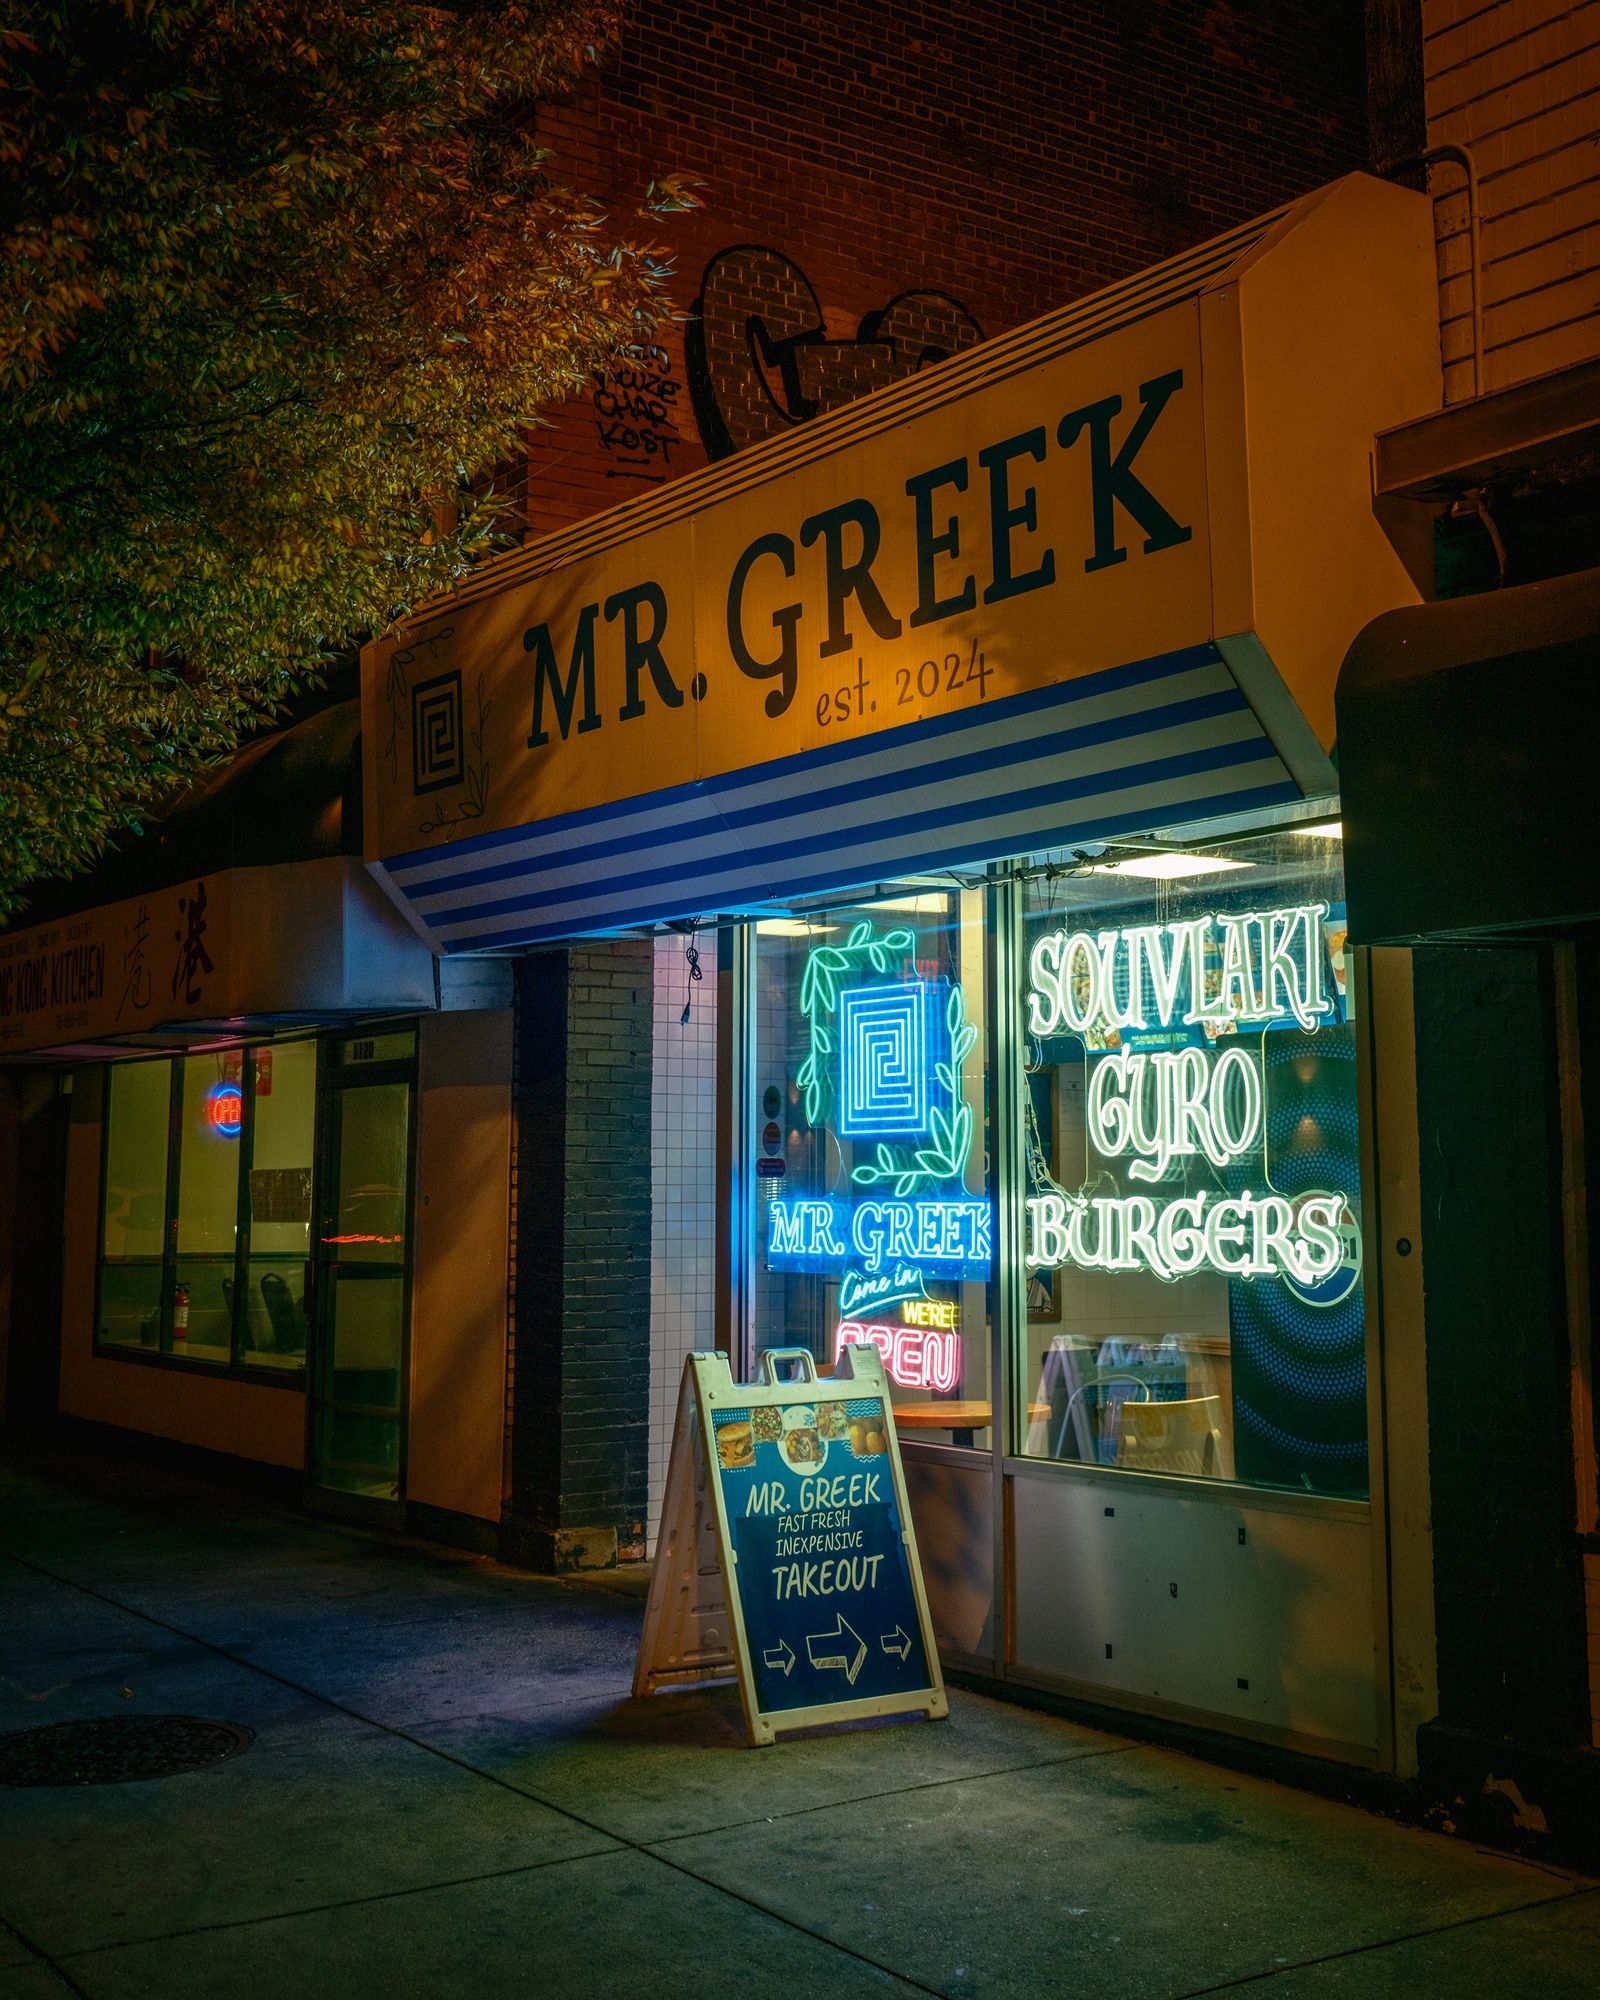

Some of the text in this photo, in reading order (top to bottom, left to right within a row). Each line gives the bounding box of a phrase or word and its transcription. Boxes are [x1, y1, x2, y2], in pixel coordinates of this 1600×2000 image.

[523, 369, 1191, 749] MR. GREEK
[816, 638, 994, 726] est. 2024
[16, 955, 47, 1016] KONG
[51, 942, 104, 1008] KITCHEN
[1030, 904, 1329, 1034] SOUVLAKI
[1088, 1043, 1260, 1182] GYRO
[770, 1201, 990, 1272] MR. GREEK
[1026, 1190, 1342, 1284] BURGERS
[841, 1263, 918, 1310] Come in
[746, 1472, 881, 1518] MR. GREEK
[778, 1509, 850, 1533] FAST FRESH
[772, 1553, 884, 1600] TAKEOUT
[775, 1530, 863, 1557] INEXPENSIVE
